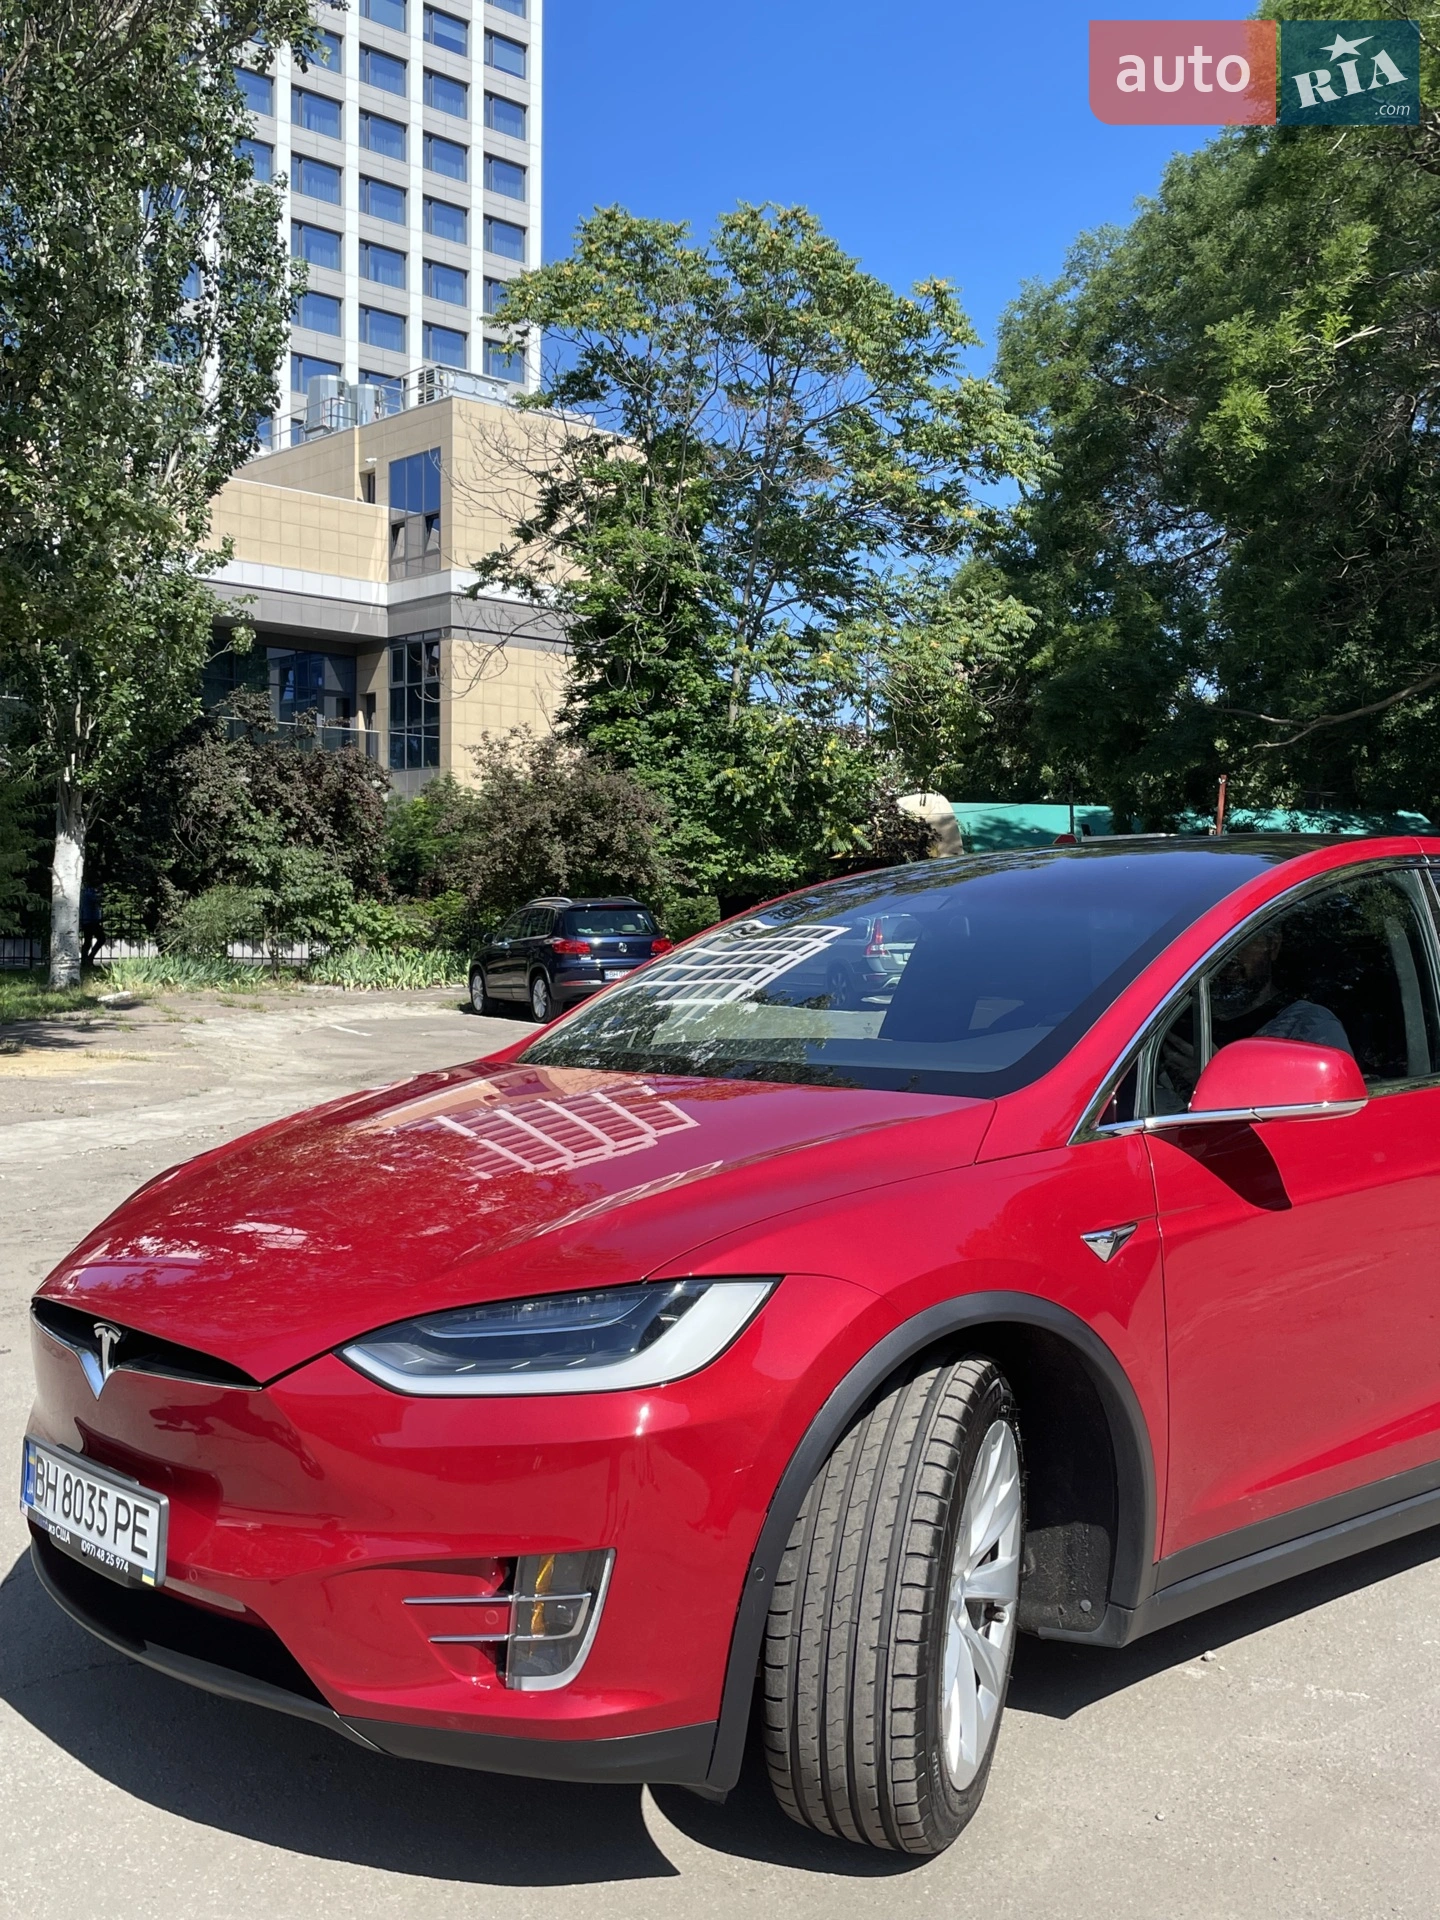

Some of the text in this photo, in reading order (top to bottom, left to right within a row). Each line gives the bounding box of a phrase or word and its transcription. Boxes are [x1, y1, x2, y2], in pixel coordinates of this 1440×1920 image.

[36, 1455, 150, 1559] BH 8035 PE
[96, 1548, 105, 1562] 48
[105, 1552, 115, 1567] 25
[115, 1557, 129, 1573] 974
